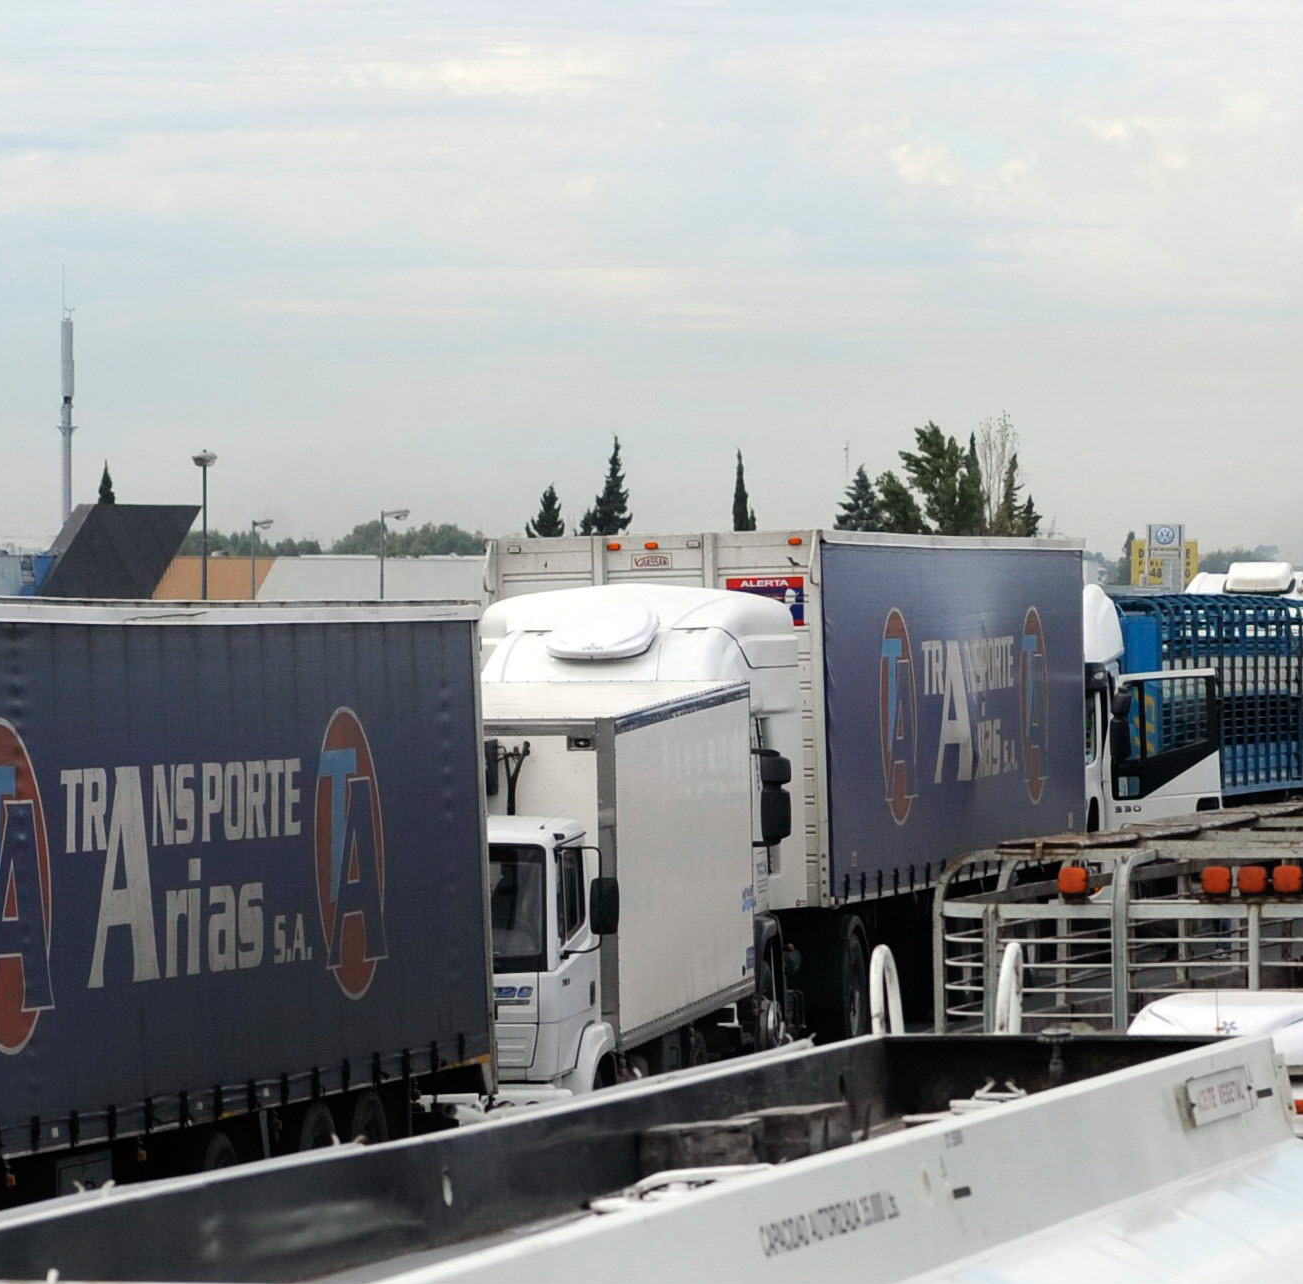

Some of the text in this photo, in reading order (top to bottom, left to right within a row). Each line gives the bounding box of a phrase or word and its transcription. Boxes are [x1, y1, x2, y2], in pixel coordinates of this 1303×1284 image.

[739, 578, 789, 588] ALERTA
[60, 757, 302, 854] TRANSPORTE
[273, 912, 313, 965] S.A.
